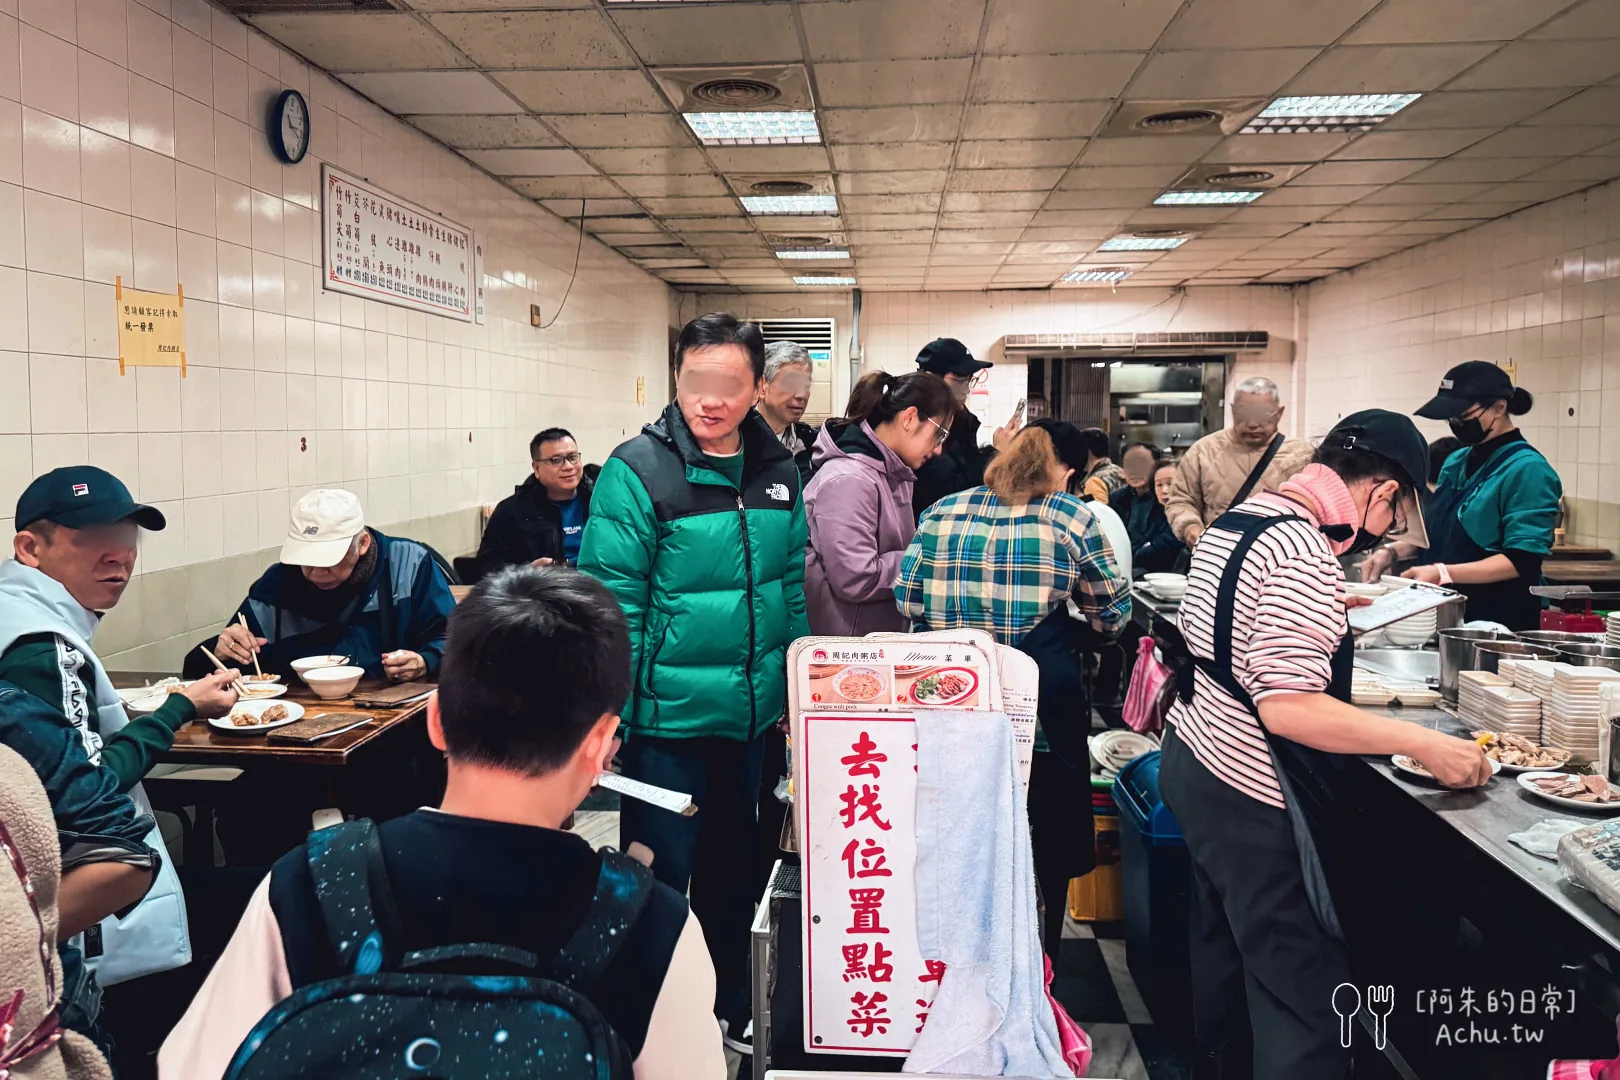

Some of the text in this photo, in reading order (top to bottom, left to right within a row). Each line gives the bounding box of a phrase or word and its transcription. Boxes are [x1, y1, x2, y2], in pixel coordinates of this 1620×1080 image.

[124, 305, 179, 318] 懇請顧客記得索取
[125, 321, 154, 332] 統一發票
[832, 651, 878, 660] 周記肉粥店
[902, 651, 937, 661] Menu
[945, 654, 972, 662] 菜單
[839, 731, 893, 1038] 去找位置點菜
